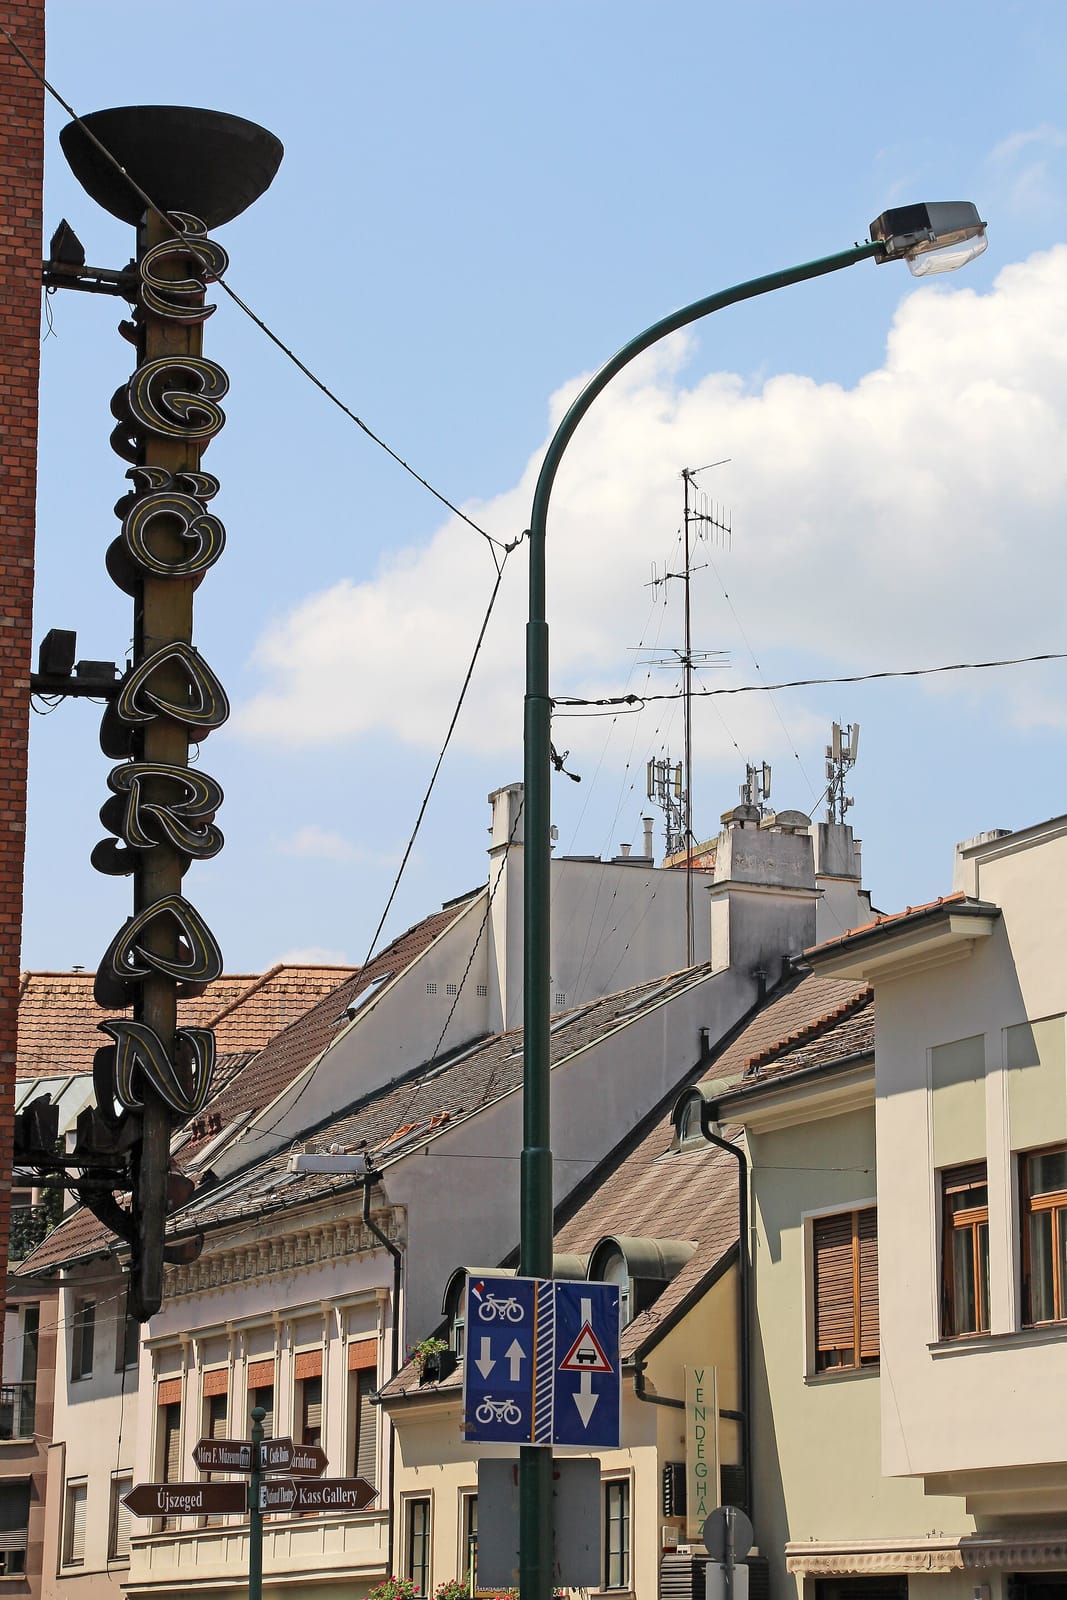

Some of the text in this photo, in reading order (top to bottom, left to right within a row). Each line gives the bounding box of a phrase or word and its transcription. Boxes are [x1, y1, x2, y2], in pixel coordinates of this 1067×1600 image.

[695, 1369, 708, 1536] VENDÉGHÁZ
[157, 1487, 203, 1513] Újszeged
[299, 1486, 358, 1507] Kass Gallery
